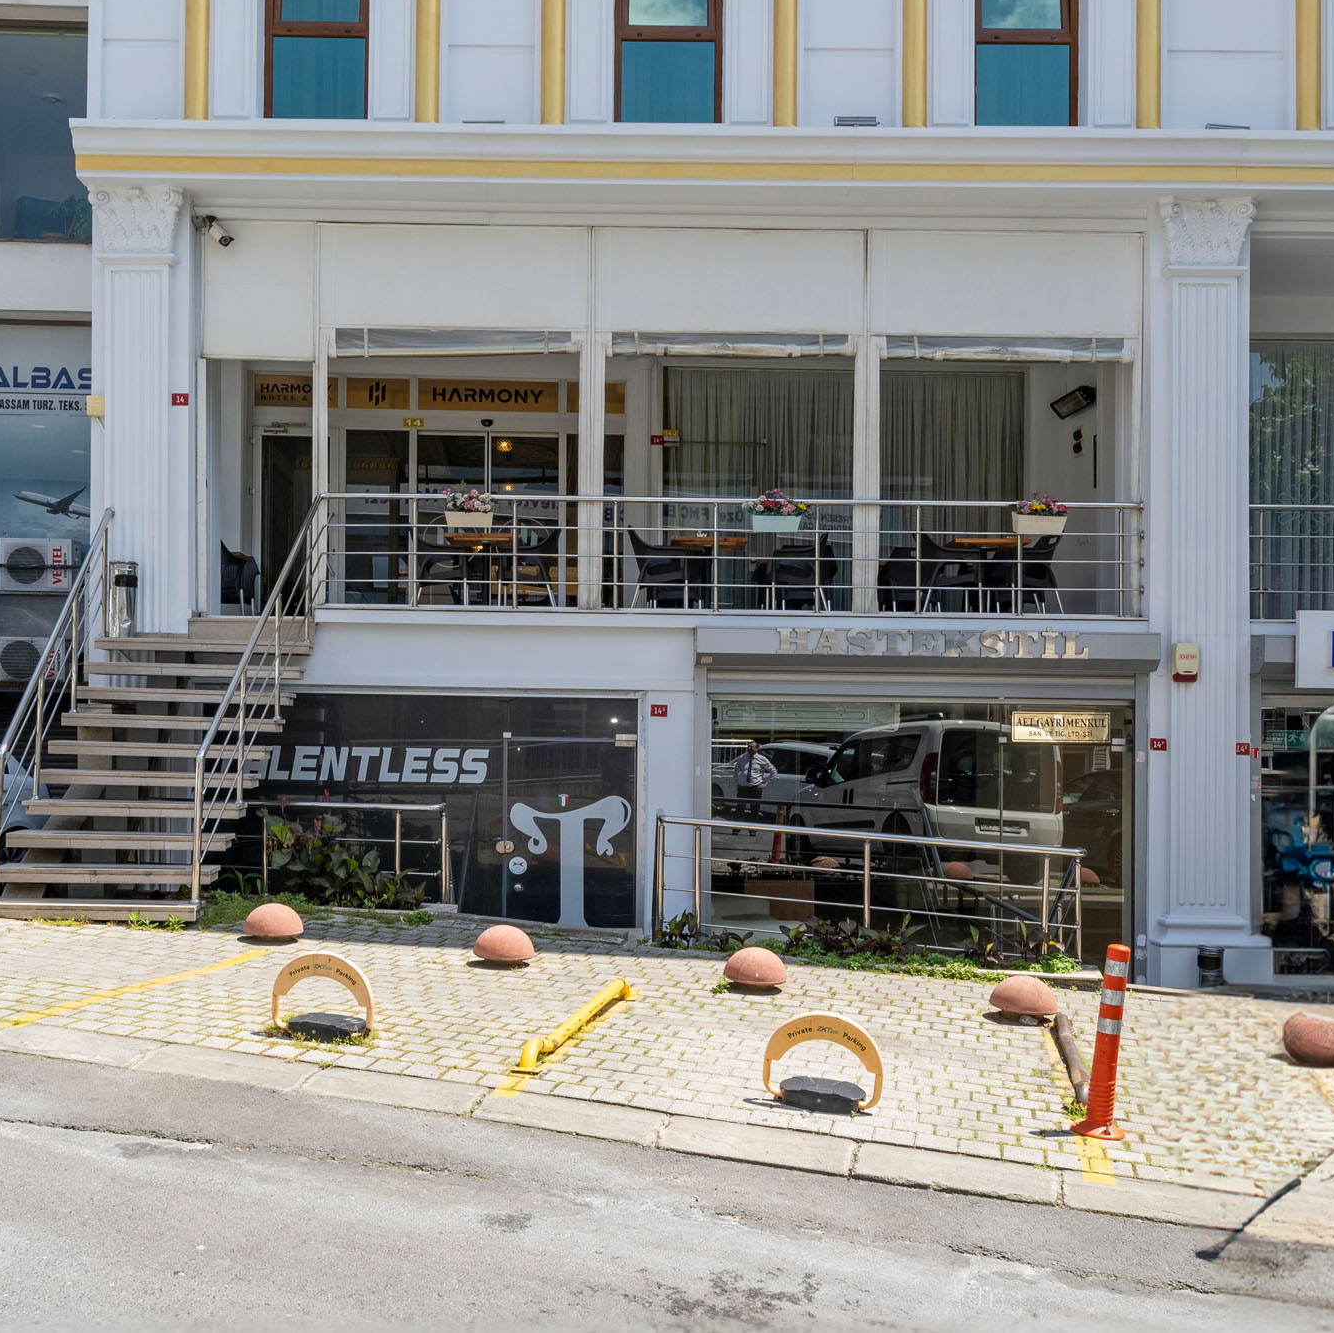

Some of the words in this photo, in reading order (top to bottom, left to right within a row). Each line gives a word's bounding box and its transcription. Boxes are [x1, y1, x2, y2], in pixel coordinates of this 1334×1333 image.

[260, 383, 333, 394] HARMO
[432, 387, 544, 404] HARMONY
[32, 399, 56, 411] TURZ.
[59, 400, 83, 412] TEKS.
[405, 418, 422, 427] 14
[775, 625, 1090, 660] HASTEKSTİL
[1036, 716, 1107, 728] GAYRİMENKUL
[288, 965, 310, 977] Private
[335, 968, 357, 986] Parking
[787, 1027, 813, 1039] Private
[842, 1032, 867, 1052] Parking
